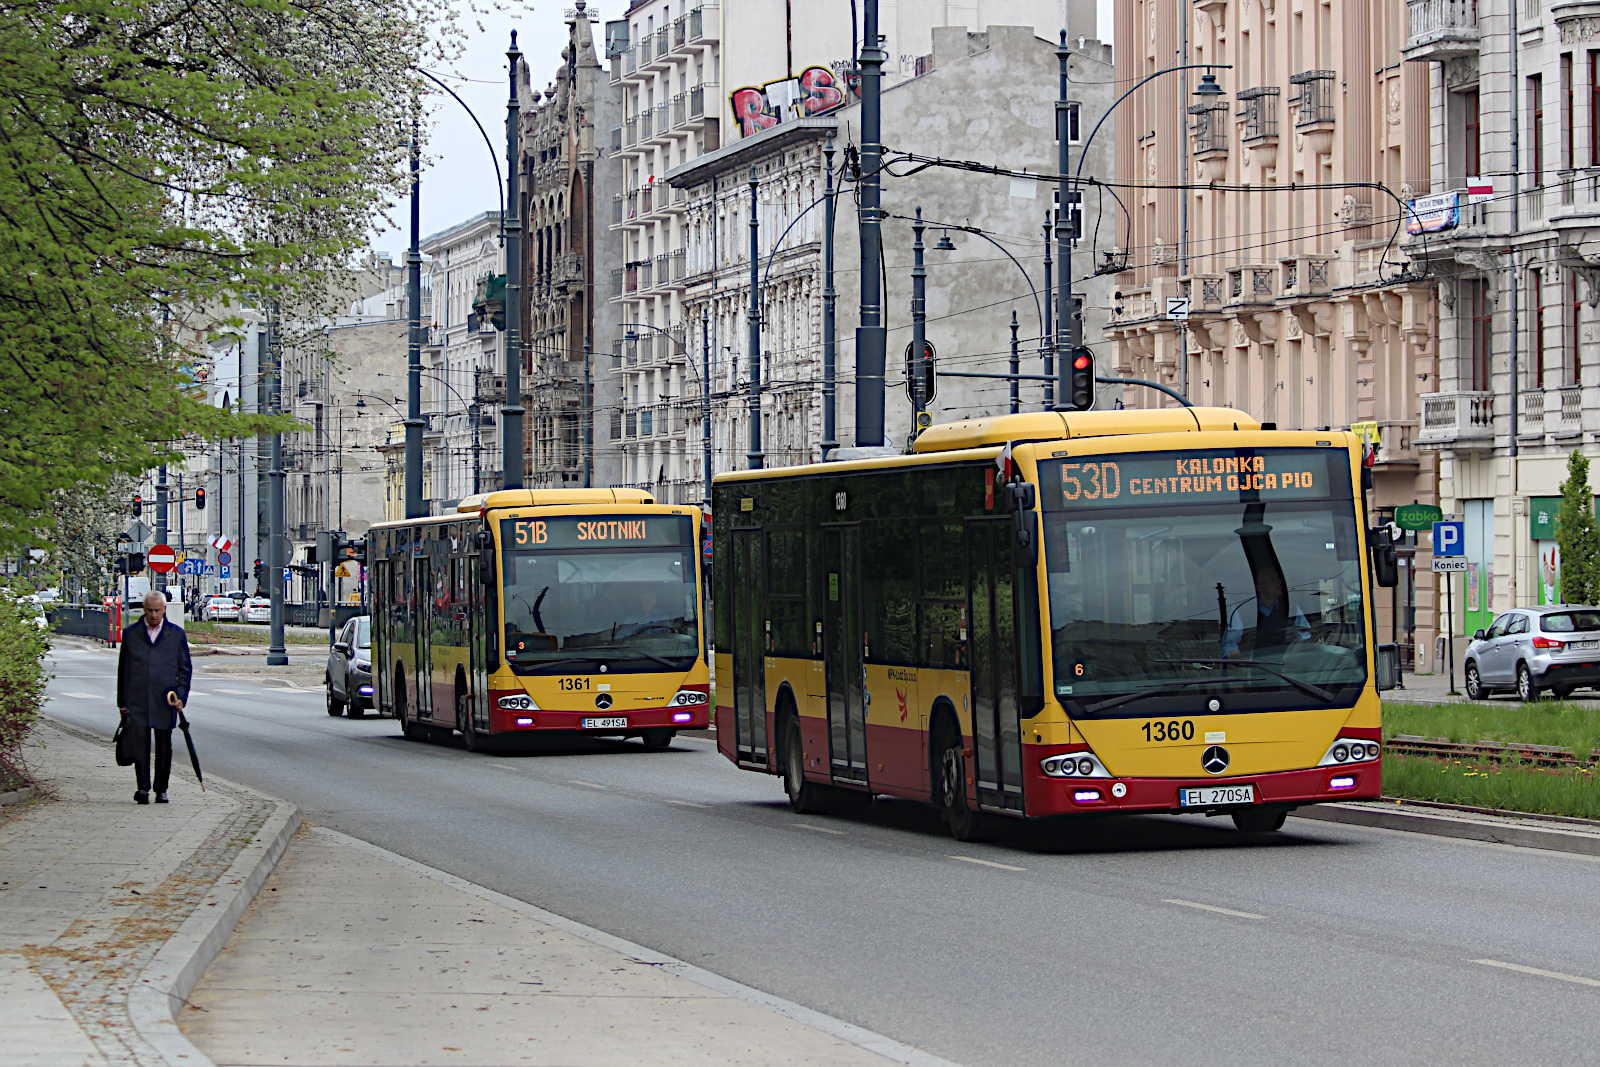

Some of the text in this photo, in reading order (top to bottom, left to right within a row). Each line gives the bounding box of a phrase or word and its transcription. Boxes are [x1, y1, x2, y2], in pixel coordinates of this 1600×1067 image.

[730, 65, 844, 138] RTS
[1177, 456, 1265, 475] KALONKA
[1062, 462, 1313, 500] 53D CENTRUM OJCA PIO
[1402, 510, 1439, 521] żabka
[515, 521, 646, 544] 51B SKOTNIKI
[1441, 525, 1458, 552] P
[1434, 561, 1465, 569] Koniec
[1075, 664, 1084, 676] 6
[558, 678, 590, 690] 1361
[587, 718, 626, 728] EL 491SA
[1141, 720, 1195, 742] 1360
[1188, 788, 1251, 804] EL 270SA
